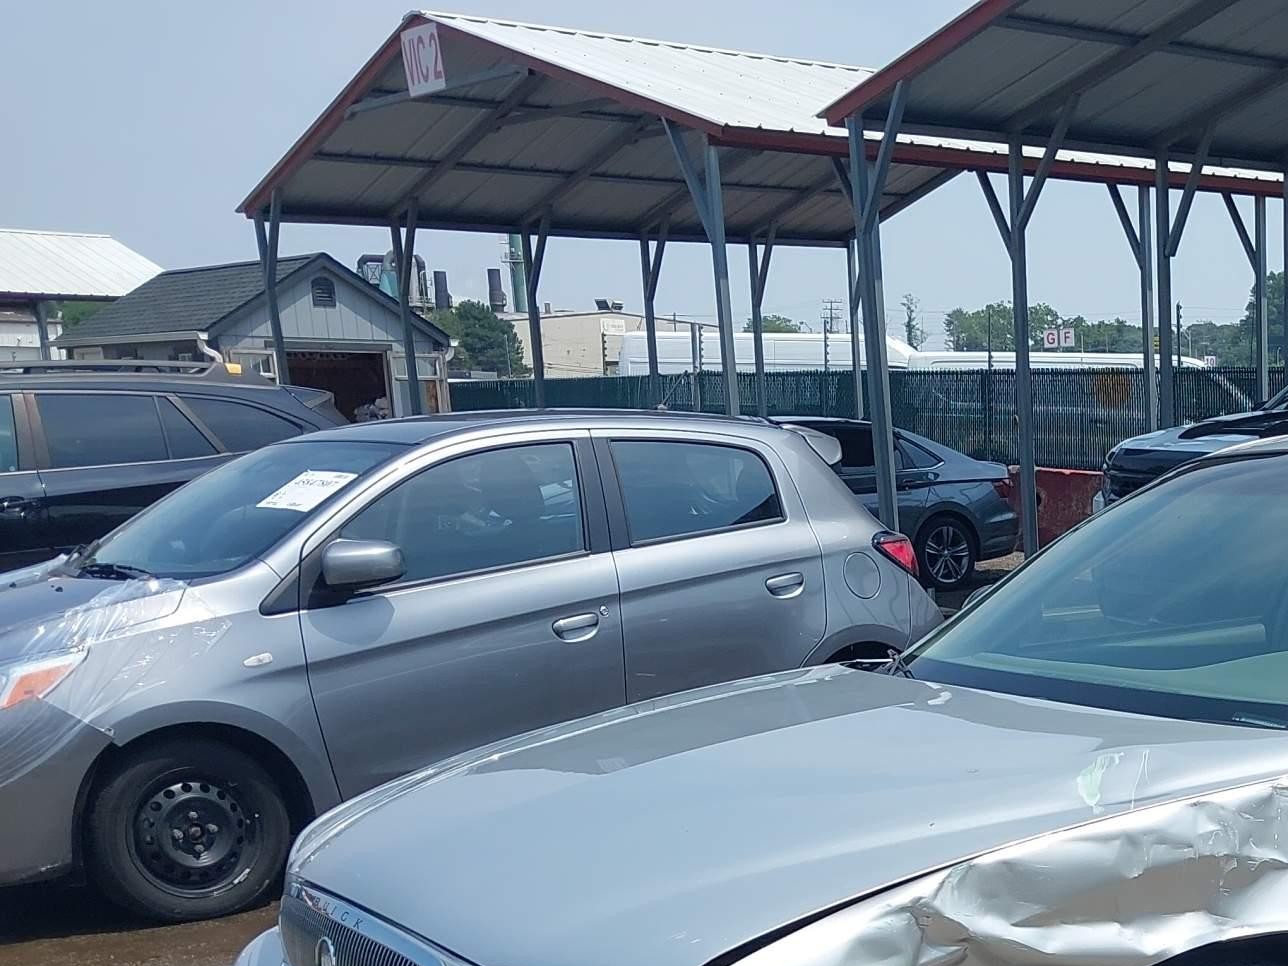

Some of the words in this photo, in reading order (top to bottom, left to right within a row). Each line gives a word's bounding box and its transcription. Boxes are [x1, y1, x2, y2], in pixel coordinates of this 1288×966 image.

[403, 35, 429, 87] VIC
[429, 33, 442, 80] 2
[1046, 332, 1056, 345] G
[1064, 331, 1071, 344] F
[313, 896, 363, 930] BUICK
